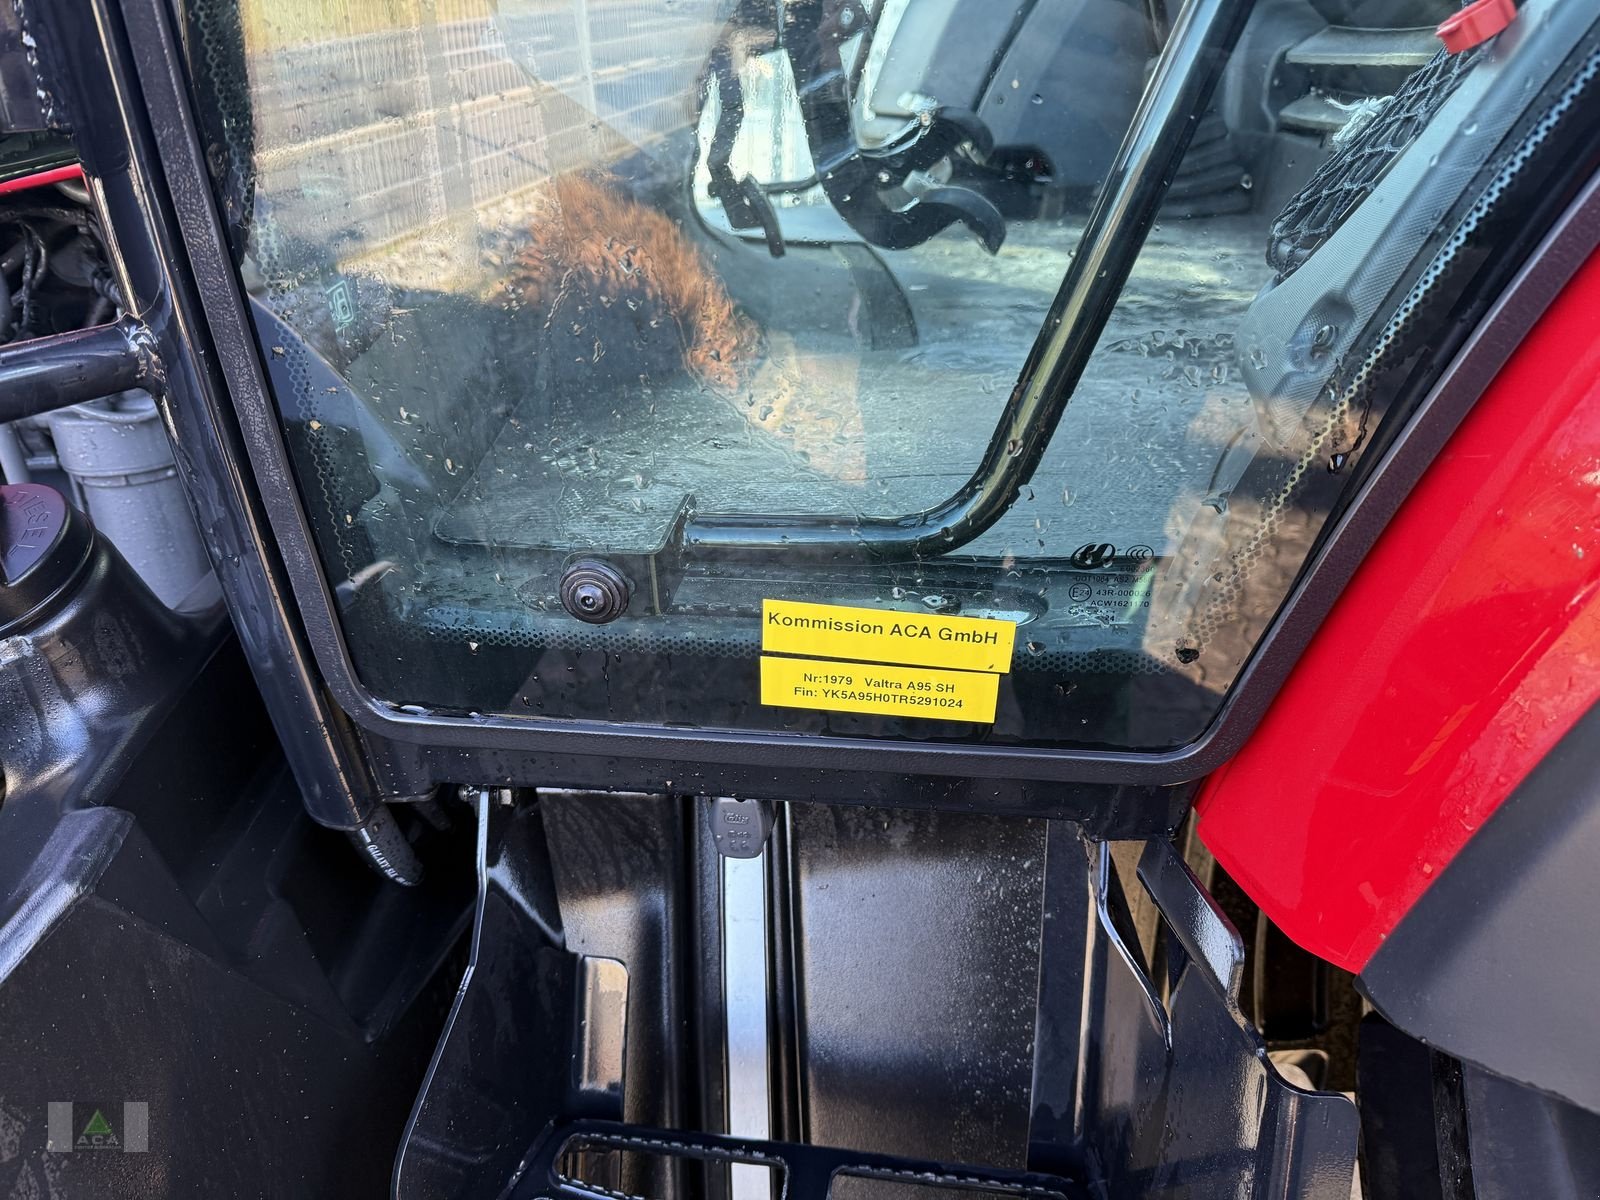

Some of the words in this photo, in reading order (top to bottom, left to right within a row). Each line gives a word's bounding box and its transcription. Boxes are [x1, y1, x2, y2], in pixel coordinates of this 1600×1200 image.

[768, 612, 884, 635] Kommission
[890, 623, 932, 639] ACA
[938, 627, 998, 645] GmbH
[803, 673, 853, 686] Nr:1979
[864, 677, 902, 690] Valtra
[907, 681, 932, 691] A95
[935, 683, 955, 693] SH
[794, 687, 817, 697] Fin:
[822, 688, 963, 709] YK5A95H0TR5291024
